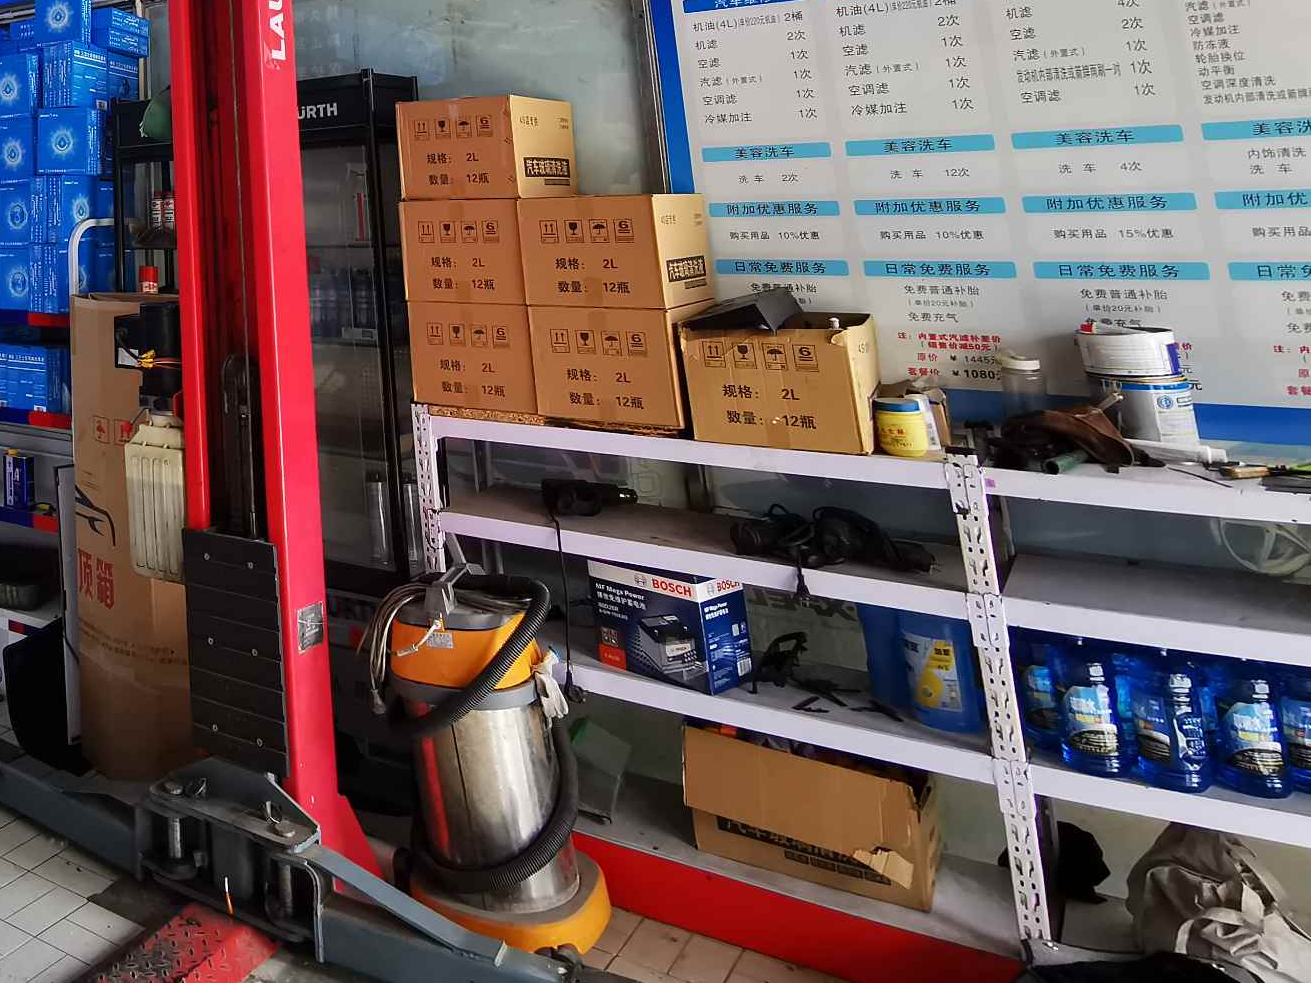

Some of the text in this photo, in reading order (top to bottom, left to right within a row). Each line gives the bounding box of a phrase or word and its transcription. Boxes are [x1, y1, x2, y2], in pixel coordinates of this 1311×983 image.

[937, 14, 960, 27] 2次
[1122, 17, 1143, 29] 2次
[787, 30, 807, 41] 2次
[842, 44, 868, 56] 空滤
[1126, 39, 1147, 51] 1次
[790, 49, 809, 60] 1次
[946, 56, 967, 68] 1次
[793, 69, 812, 79] 1次
[849, 76, 971, 96] 空调滤 1次
[851, 97, 974, 116] 冷媒加注 1次
[705, 113, 752, 125] 冷媒加注
[1057, 130, 1135, 145] 美容洗车
[884, 139, 953, 152] 美容洗车
[426, 153, 479, 164] 规格： 2L
[735, 147, 794, 158] 美容洗车
[945, 168, 970, 177] 12次
[1120, 161, 1142, 172] 4次
[429, 173, 490, 185] 数量： 12瓶
[727, 203, 818, 215] 附加优惠服务
[875, 200, 980, 214] 附加优惠服务
[1046, 196, 1168, 210] 附加优惠服务
[880, 230, 984, 240] 购买用品 10%优惠
[1119, 228, 1174, 239] 15%优惠
[472, 258, 485, 267] 2L
[602, 259, 618, 269] 2L
[735, 261, 826, 274] 日常免费服务
[886, 263, 990, 276] 日常免费服务
[1059, 264, 1179, 278] 日常免费服务
[471, 279, 495, 290] 12瓶
[603, 282, 630, 294] 12瓶
[904, 284, 980, 296] 免费普通补胎
[1081, 289, 1167, 300] 免费普通补胎
[908, 312, 959, 324] 免费充气
[482, 363, 495, 373] 2L
[616, 372, 631, 383] 2L
[482, 385, 506, 397] 12瓶
[781, 389, 800, 401] 2L
[616, 397, 643, 410] 12瓶
[782, 415, 817, 430] 12瓶
[652, 578, 692, 597] BOSCH
[625, 590, 646, 601] Power
